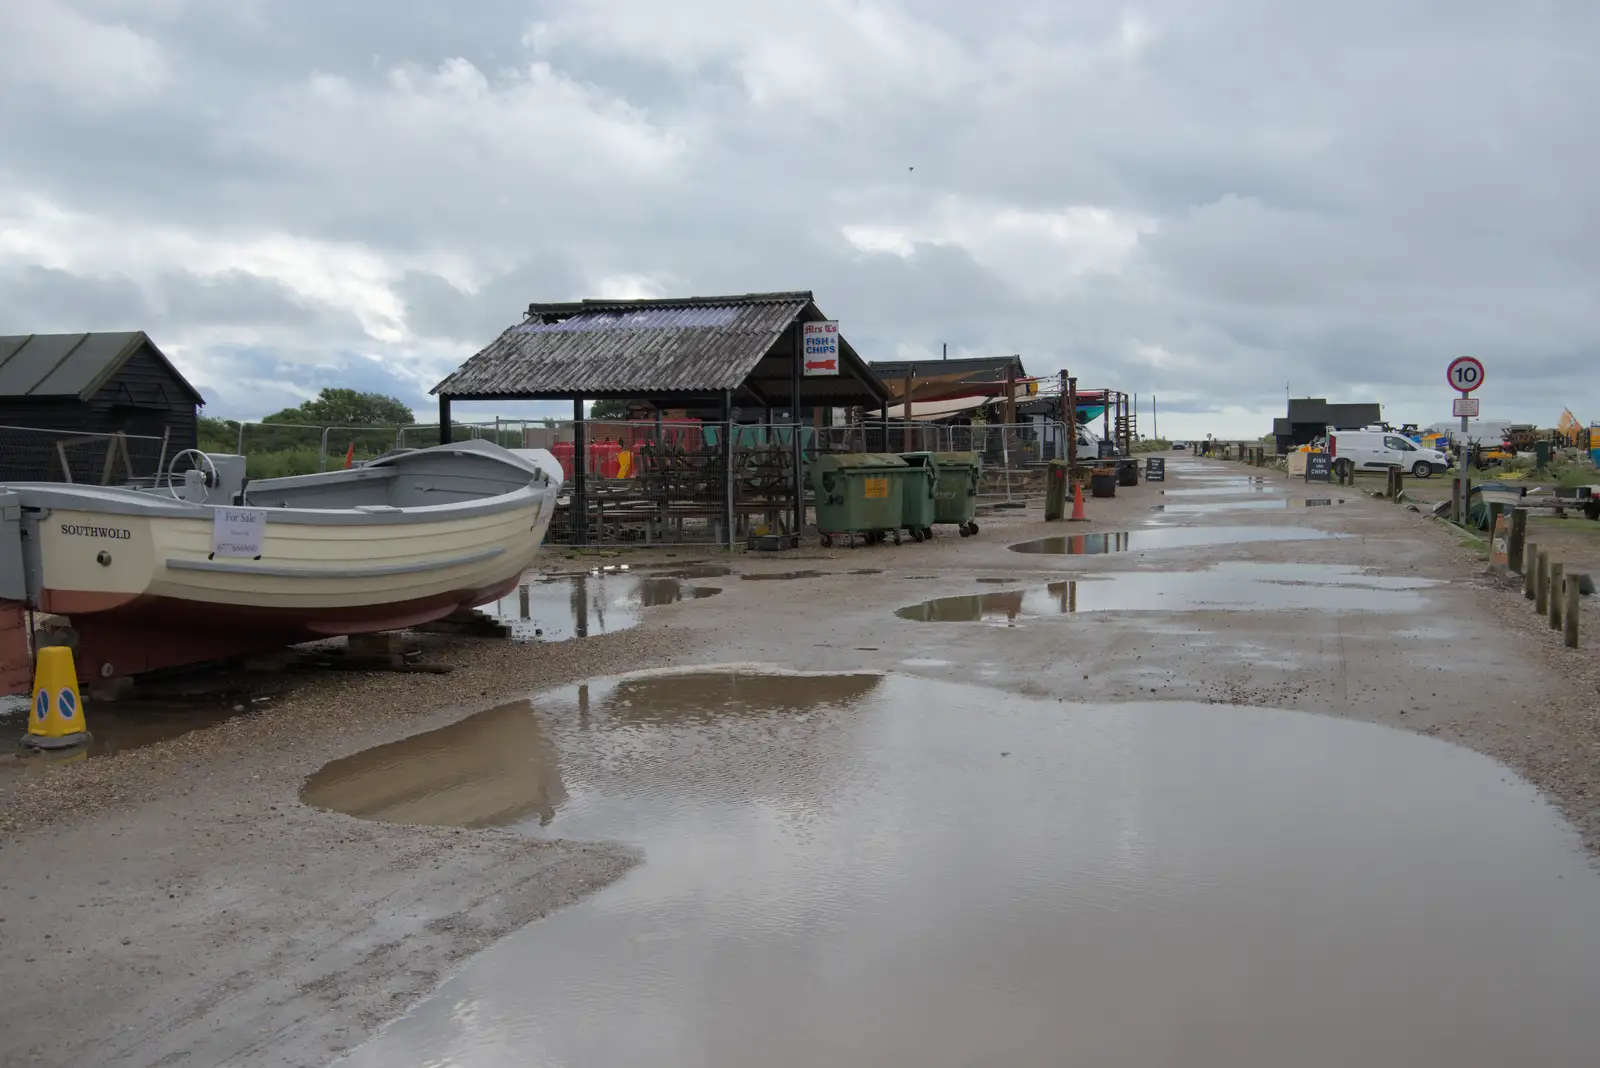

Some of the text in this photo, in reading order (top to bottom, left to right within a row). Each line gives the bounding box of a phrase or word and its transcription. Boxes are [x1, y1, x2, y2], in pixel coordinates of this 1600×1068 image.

[805, 325, 823, 335] Mrs
[806, 337, 829, 345] FISH
[805, 346, 836, 354] CHIPS
[1455, 367, 1477, 383] 10
[225, 511, 256, 523] For Sale
[61, 524, 131, 540] SOUTHWOLD
